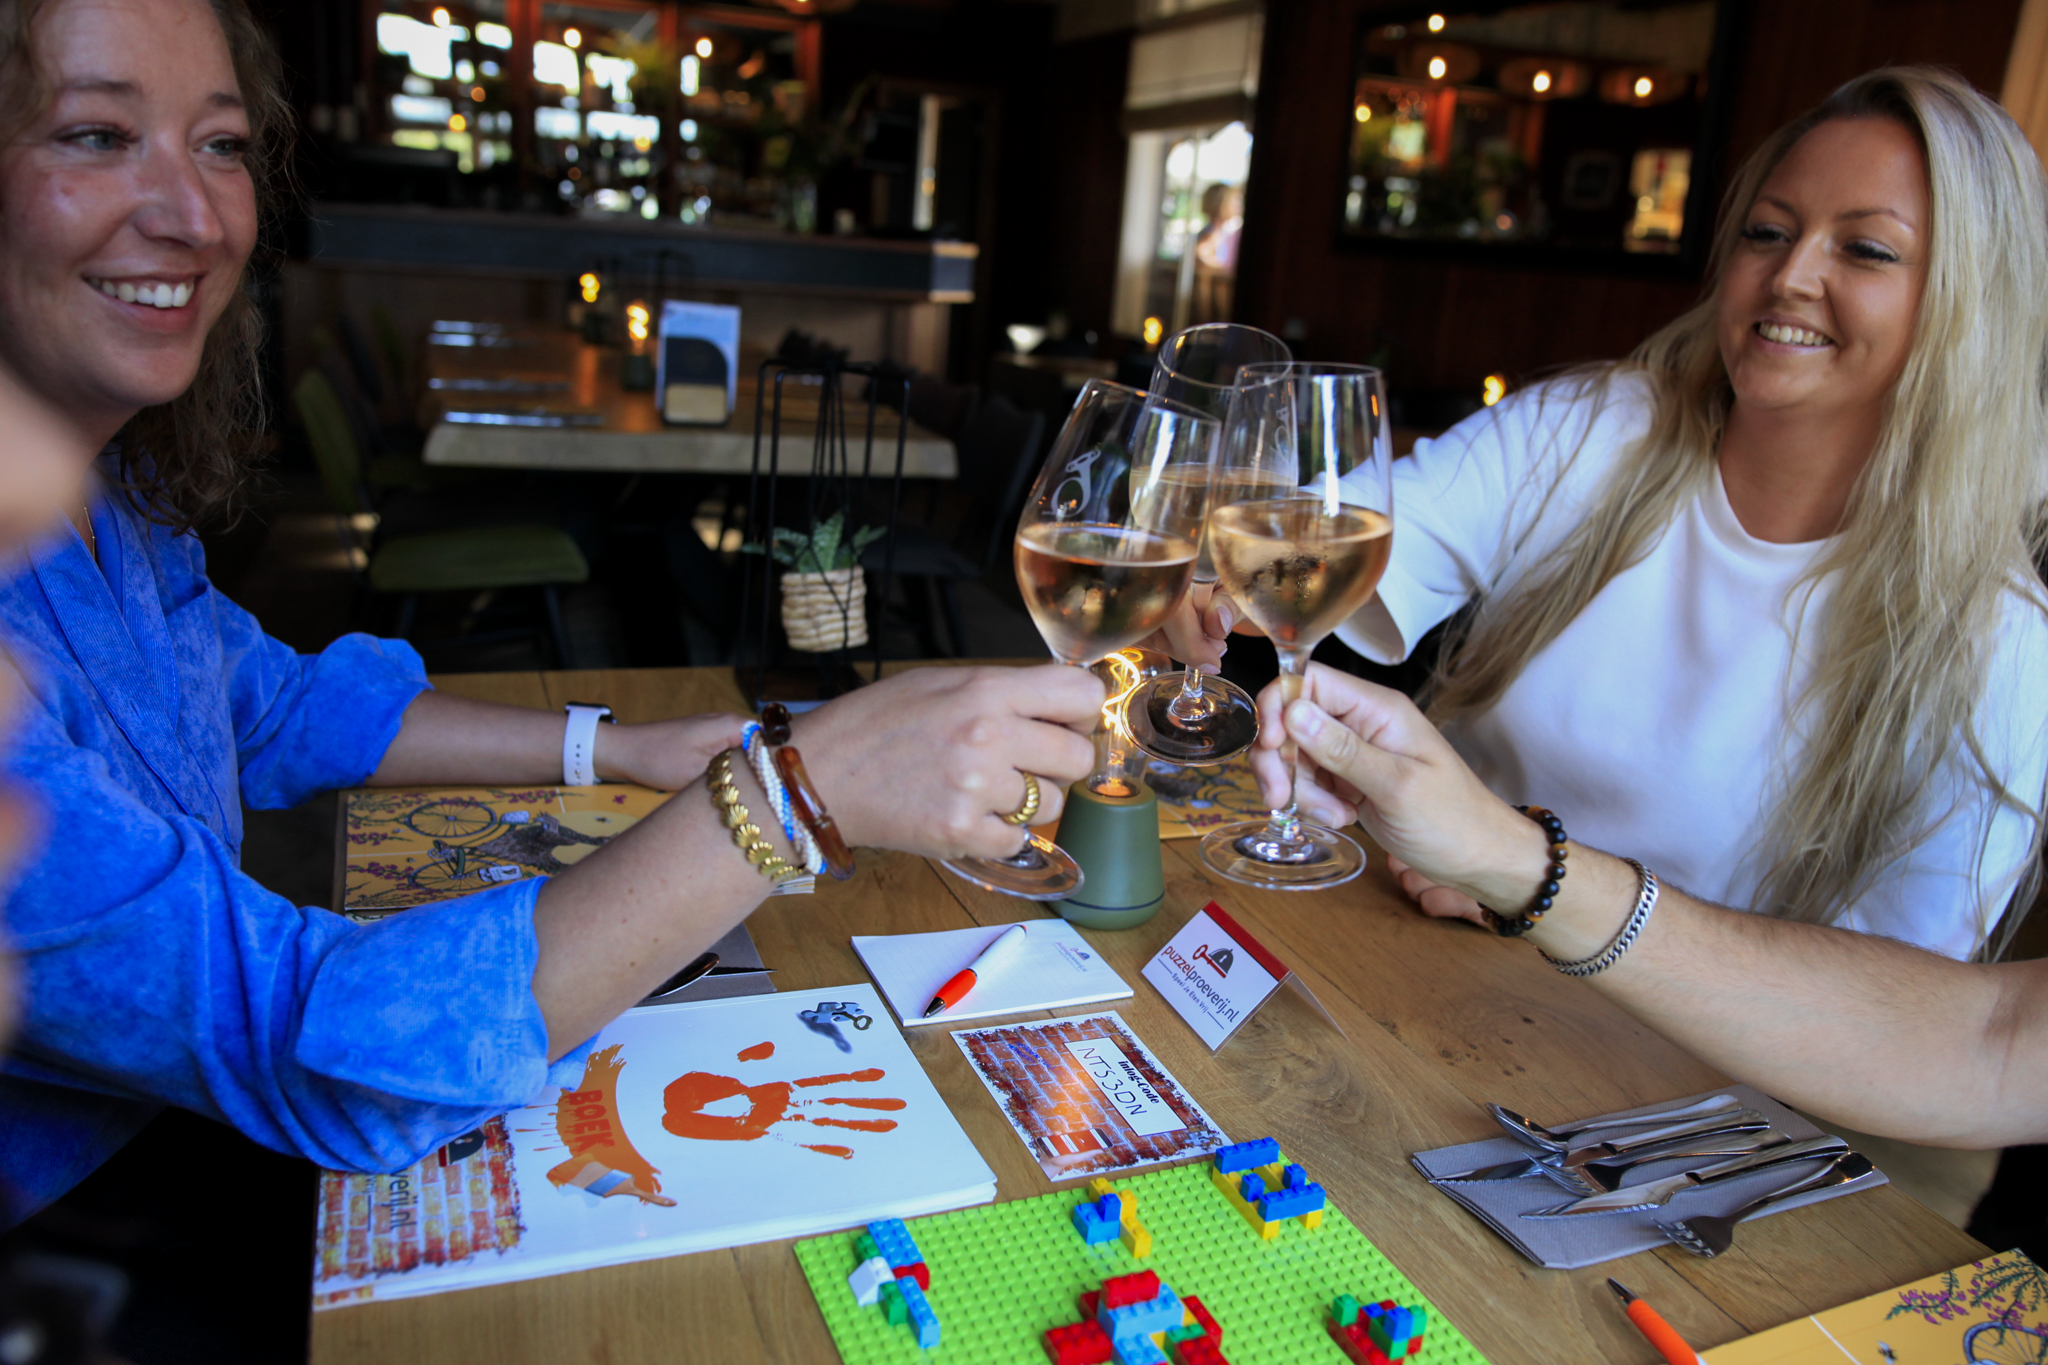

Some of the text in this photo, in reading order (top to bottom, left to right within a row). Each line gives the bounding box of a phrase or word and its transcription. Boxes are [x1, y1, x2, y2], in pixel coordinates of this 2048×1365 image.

[1161, 946, 1240, 1023] puzzelproeverij.nl
[1172, 973, 1185, 987] Speel
[1188, 991, 1200, 1004] Eten
[1199, 1001, 1209, 1013] Vrij
[1077, 1047, 1147, 1116] NTS3DN
[1118, 1060, 1160, 1104] inlog-Code
[565, 1089, 615, 1152] BOEK
[381, 1168, 419, 1231] verij.nl
